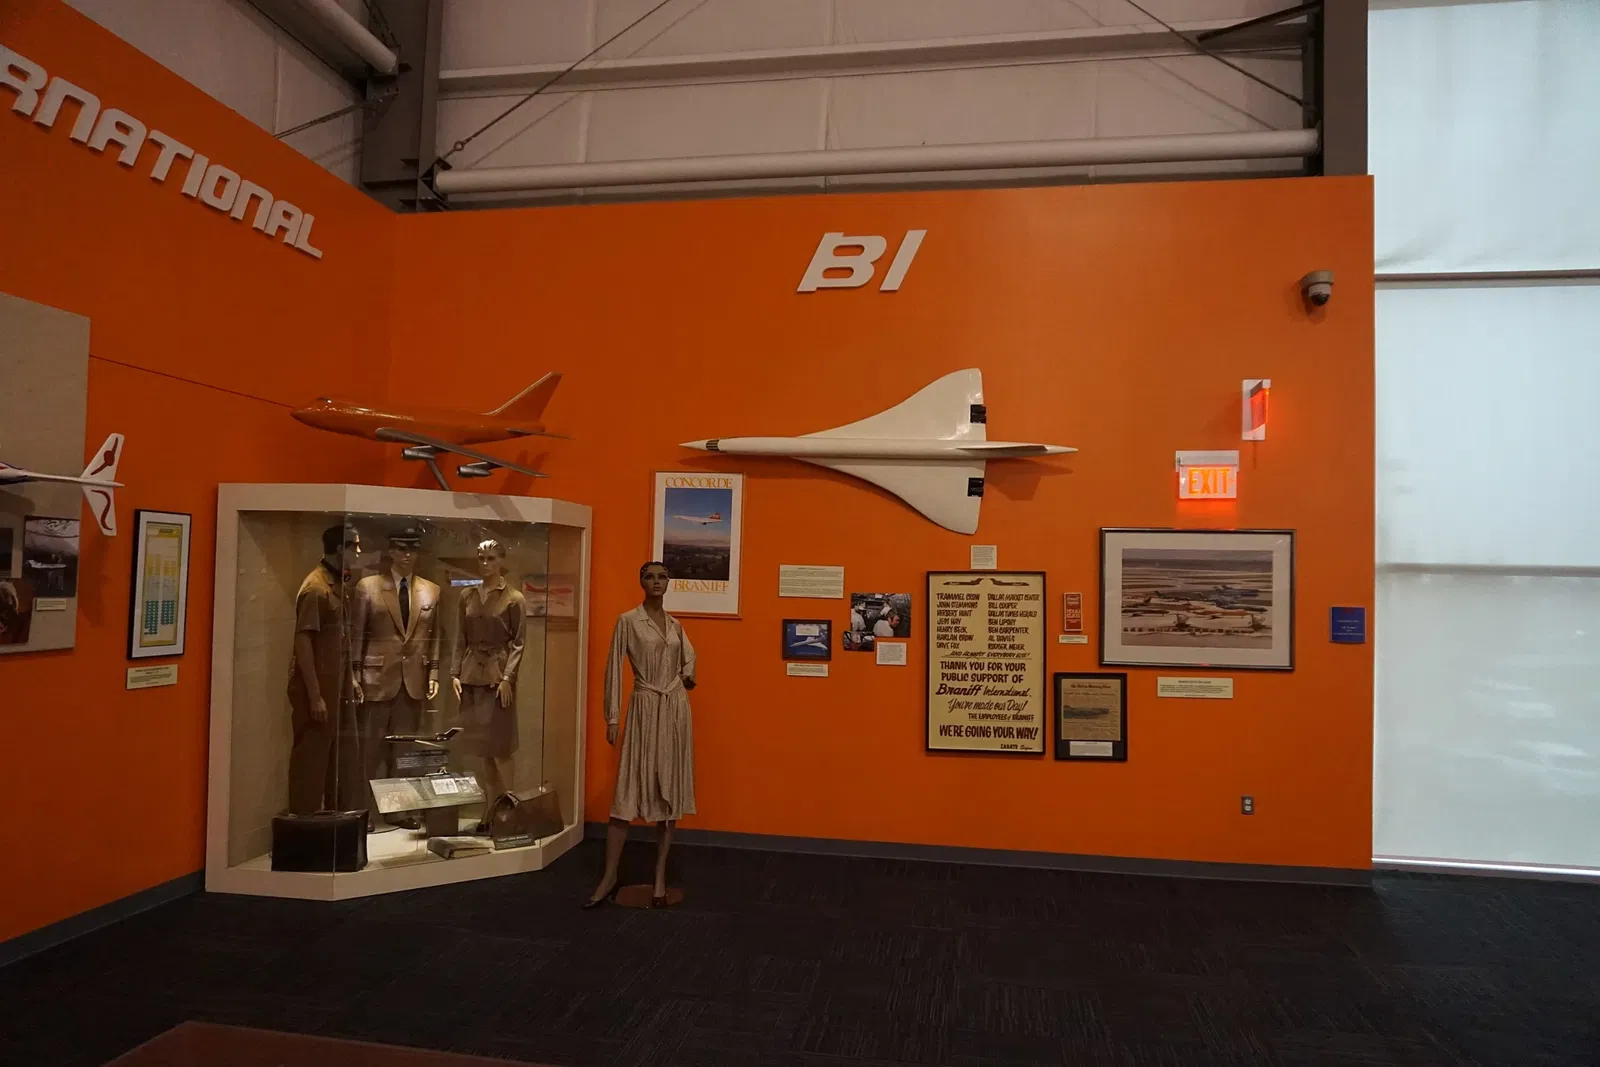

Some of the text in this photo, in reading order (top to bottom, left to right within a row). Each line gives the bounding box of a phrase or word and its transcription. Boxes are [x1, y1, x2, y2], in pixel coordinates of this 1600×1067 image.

[796, 230, 928, 292] BI
[666, 477, 733, 488] CONCORDE
[1188, 468, 1230, 494] EXIT
[674, 580, 729, 592] BRANIFF
[940, 661, 1026, 671] THANK YOU FOR YOUR
[941, 672, 1023, 683] PUBLIC SUPPORT OF
[936, 683, 983, 696] Braniff
[973, 700, 993, 710] made
[994, 701, 1006, 710] our
[940, 725, 1038, 740] WE'RE GOING YOUR WAY!
